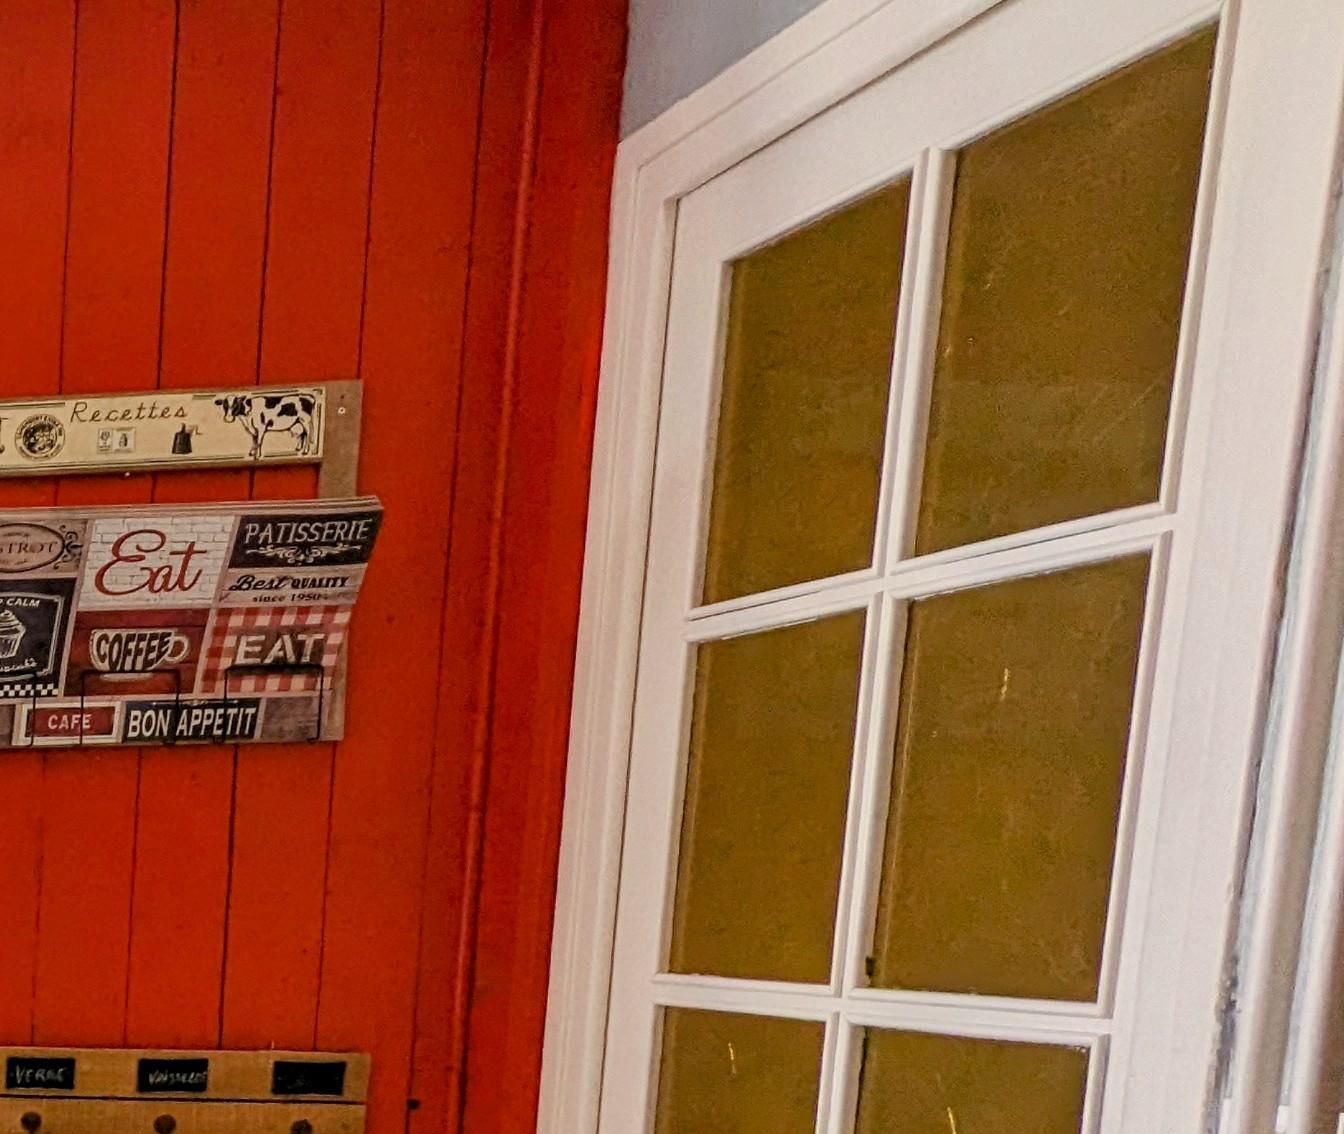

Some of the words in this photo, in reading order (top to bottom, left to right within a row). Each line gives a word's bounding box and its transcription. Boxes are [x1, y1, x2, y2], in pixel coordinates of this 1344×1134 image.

[69, 401, 188, 423] Recettes
[244, 518, 373, 544] PATISSERIE
[94, 528, 207, 596] Eat
[228, 574, 292, 591] Best
[291, 576, 350, 590] QUALITY
[6, 597, 41, 609] CALM
[95, 631, 173, 671] COFFEE
[234, 633, 325, 665] EAT
[127, 708, 173, 738] BON
[175, 705, 257, 738] APPETIT
